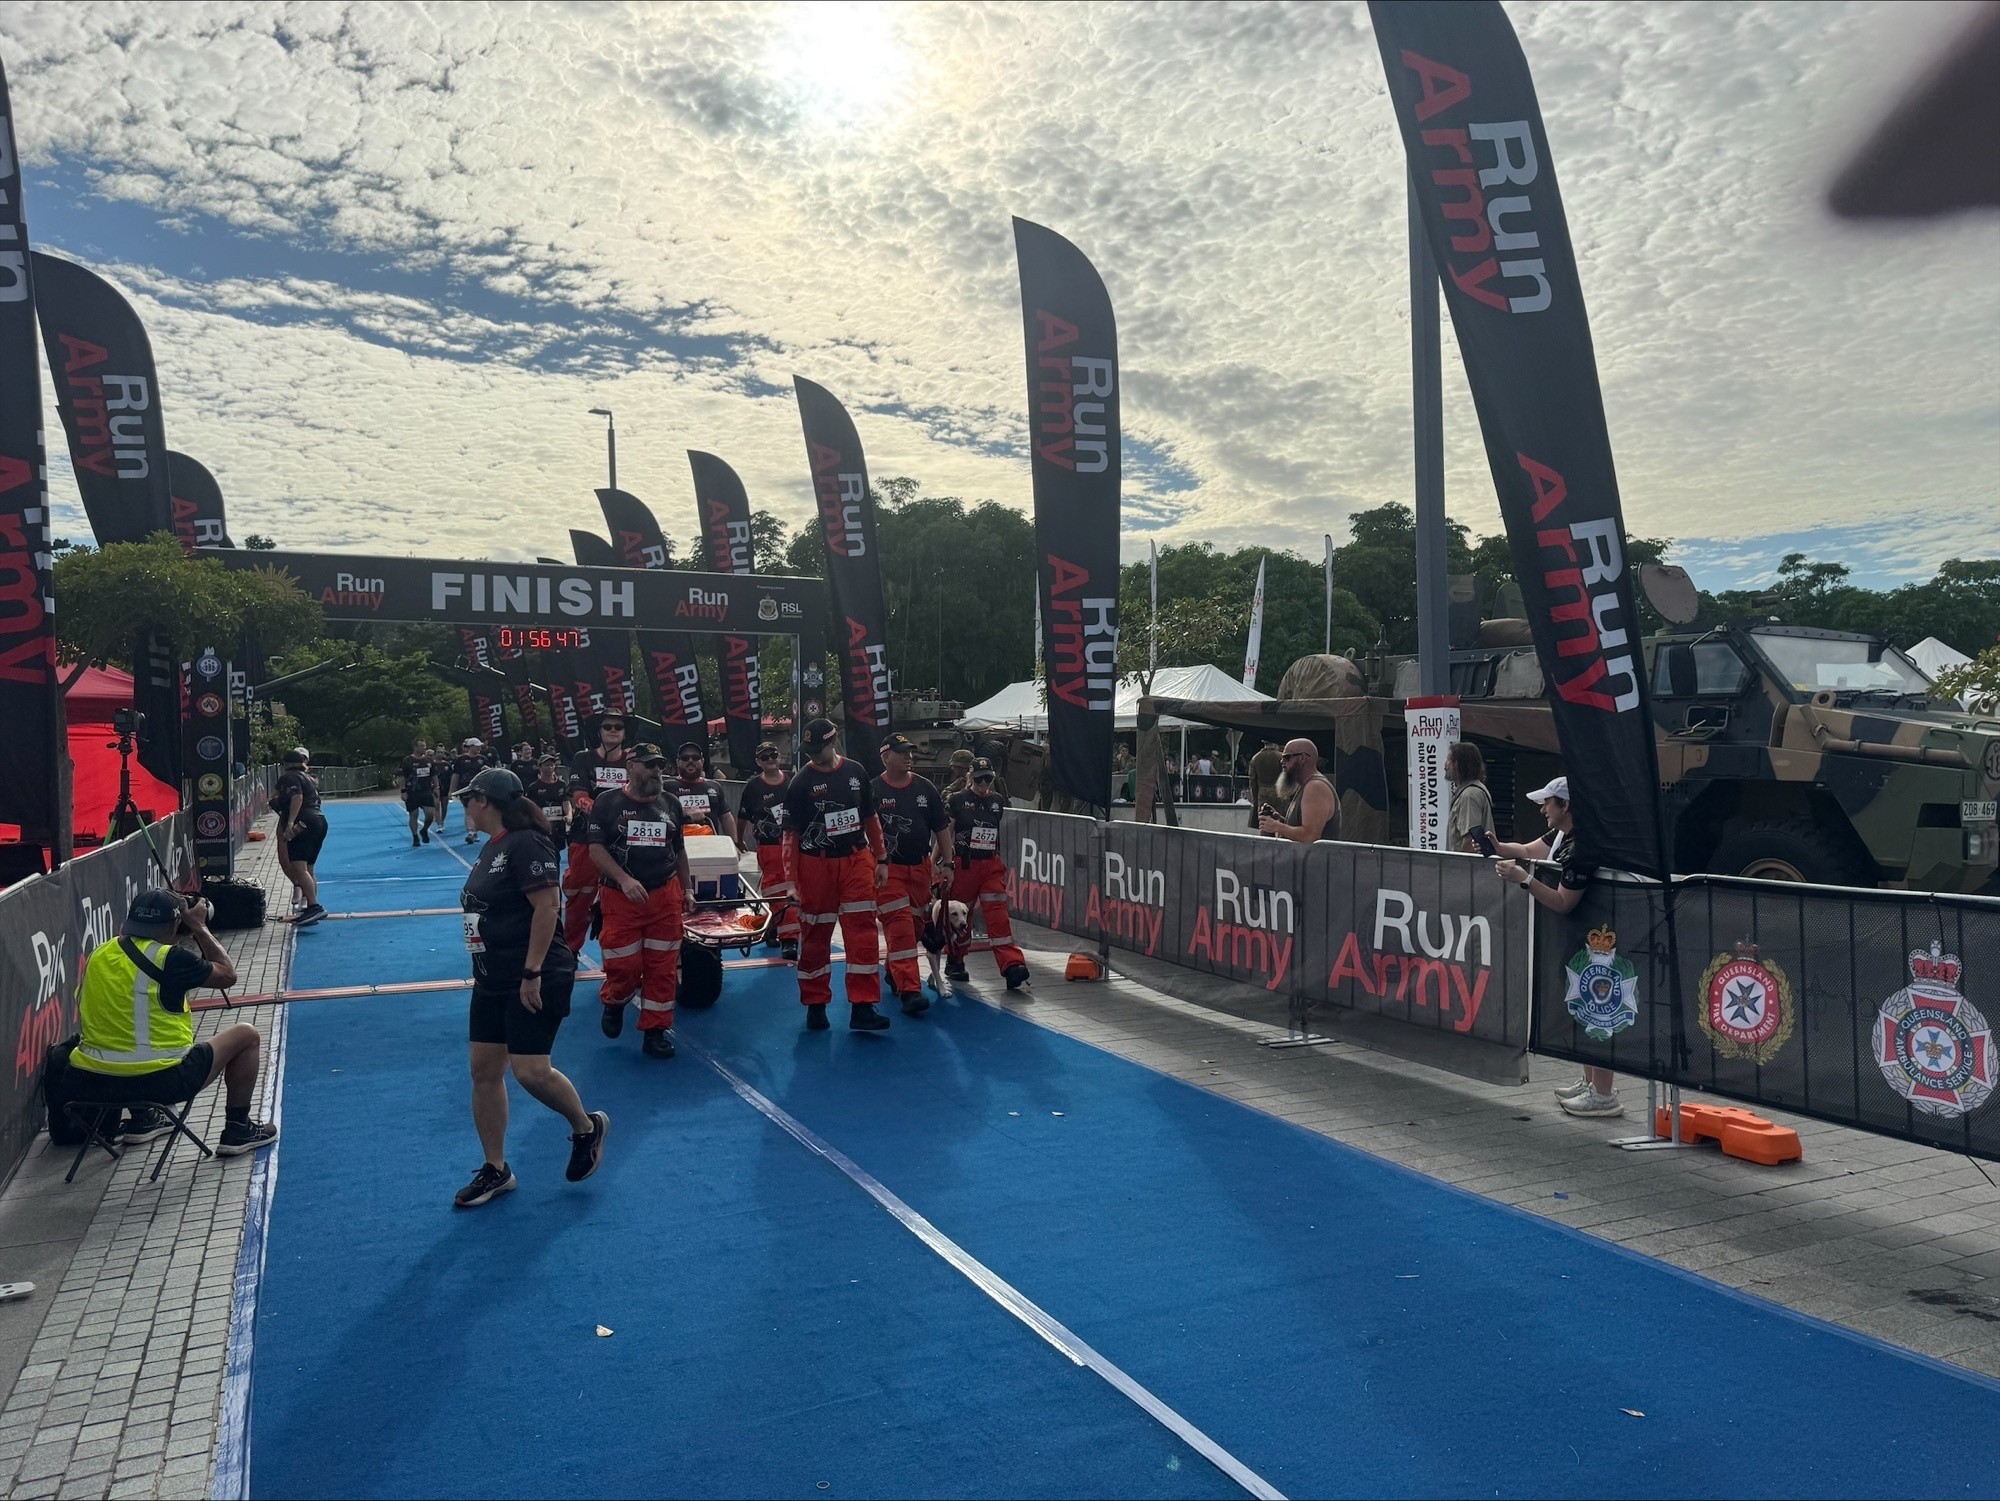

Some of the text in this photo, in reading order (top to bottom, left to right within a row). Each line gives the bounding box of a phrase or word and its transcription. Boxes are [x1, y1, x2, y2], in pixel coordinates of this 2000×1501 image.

[1401, 49, 1509, 313] Army
[1468, 120, 1552, 314] Run
[58, 332, 115, 478] Army
[1035, 308, 1080, 471] Army
[102, 375, 150, 479] Run
[1071, 355, 1114, 473] Run
[811, 441, 849, 557] Army
[837, 472, 866, 557] Run
[320, 586, 384, 612] Army
[336, 572, 385, 593] Run
[431, 571, 635, 617] FINISH
[688, 587, 729, 606] Run
[1517, 451, 1617, 713] Army
[674, 600, 729, 622] Army
[781, 602, 803, 613] RSL
[1047, 553, 1090, 709] Army
[1568, 517, 1640, 713] Run
[724, 635, 755, 721] Army
[845, 616, 877, 727] Army
[1082, 598, 1117, 711] Run
[650, 650, 688, 725] Army
[674, 663, 704, 725] Run
[865, 643, 889, 727] Run
[488, 703, 503, 738] Run
[562, 696, 580, 738] Run
[1411, 725, 1442, 739] Army
[1419, 715, 1443, 728] Run
[600, 771, 623, 780] 2830
[1418, 742, 1426, 763] RUN
[1418, 765, 1427, 780] OR
[1426, 744, 1439, 809] SUNDAY
[683, 799, 706, 807] 2759
[813, 783, 828, 793] Run
[1419, 781, 1427, 810] WALK
[632, 826, 662, 838] 2818
[830, 814, 856, 828] 1839
[975, 831, 996, 841] 2672
[1419, 812, 1427, 834] 5KM
[1428, 811, 1439, 828] 19
[544, 862, 557, 870] RSL
[1019, 837, 1066, 887] Run
[1105, 851, 1165, 907] Run
[1005, 867, 1065, 930] Army
[1084, 883, 1164, 957] Army
[1215, 867, 1294, 934] Run
[1188, 905, 1293, 991] Army
[1374, 888, 1491, 966] Run
[1328, 932, 1490, 1033] Army
[1580, 966, 1621, 996] QUEENSLAND
[1718, 966, 1774, 993] QUEENSLAND
[1587, 1000, 1617, 1014] POLICE
[1712, 1003, 1777, 1041] FIRE DEPARTMENT
[1901, 1010, 1968, 1041] QUEENSLAND
[1895, 1038, 1974, 1090] AMBULANCE SERVICE
